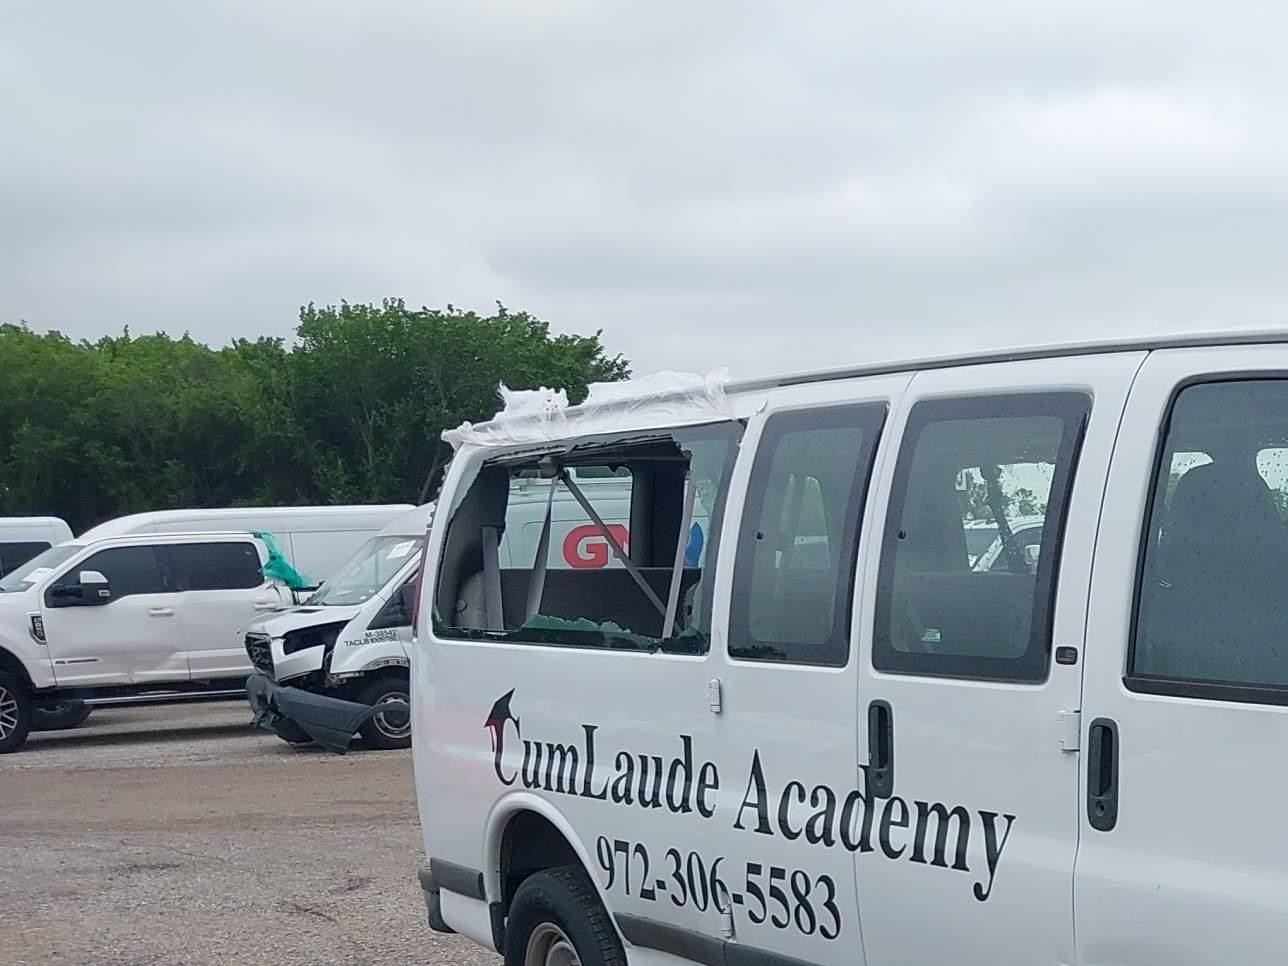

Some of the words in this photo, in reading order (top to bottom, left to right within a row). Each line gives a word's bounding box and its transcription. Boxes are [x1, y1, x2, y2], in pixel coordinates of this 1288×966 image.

[492, 714, 719, 818] CumLaude
[733, 748, 1017, 902] Academy
[596, 834, 842, 940] 972-306-5583
